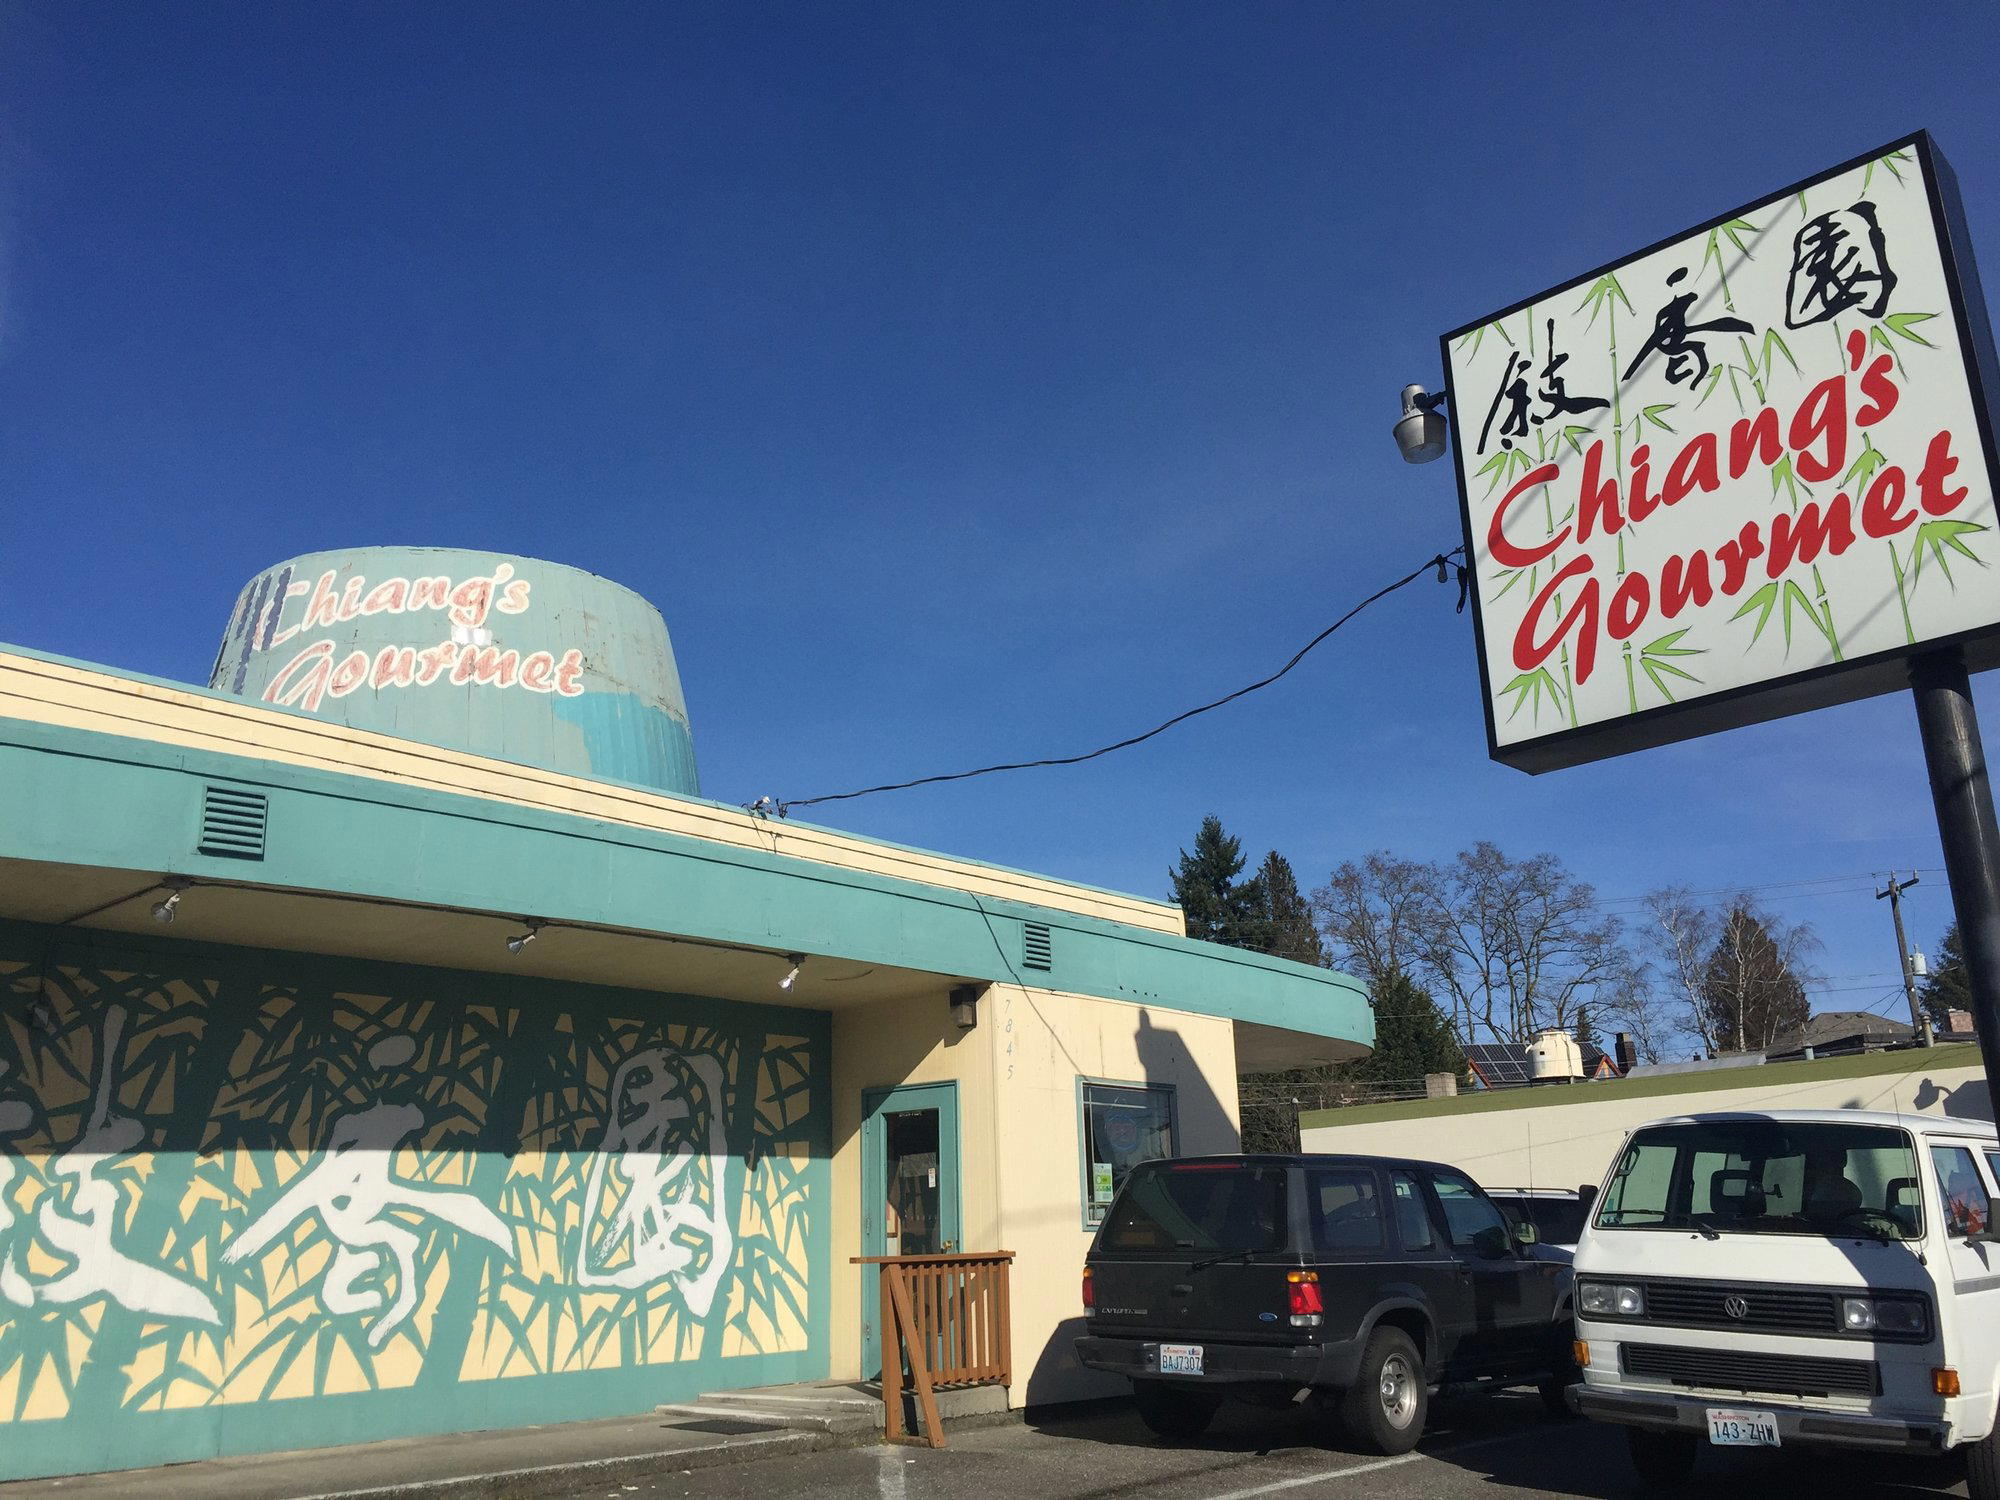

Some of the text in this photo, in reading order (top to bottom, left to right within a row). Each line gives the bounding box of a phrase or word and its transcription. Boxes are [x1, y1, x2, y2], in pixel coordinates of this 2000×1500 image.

[1488, 330, 1899, 567] Chiang's
[1513, 432, 1969, 685] Gourmet
[251, 563, 531, 651] Chiang's
[261, 639, 585, 709] Gourmet
[1004, 999, 1014, 1080] 7845
[1162, 1355, 1201, 1371] BAJ7307
